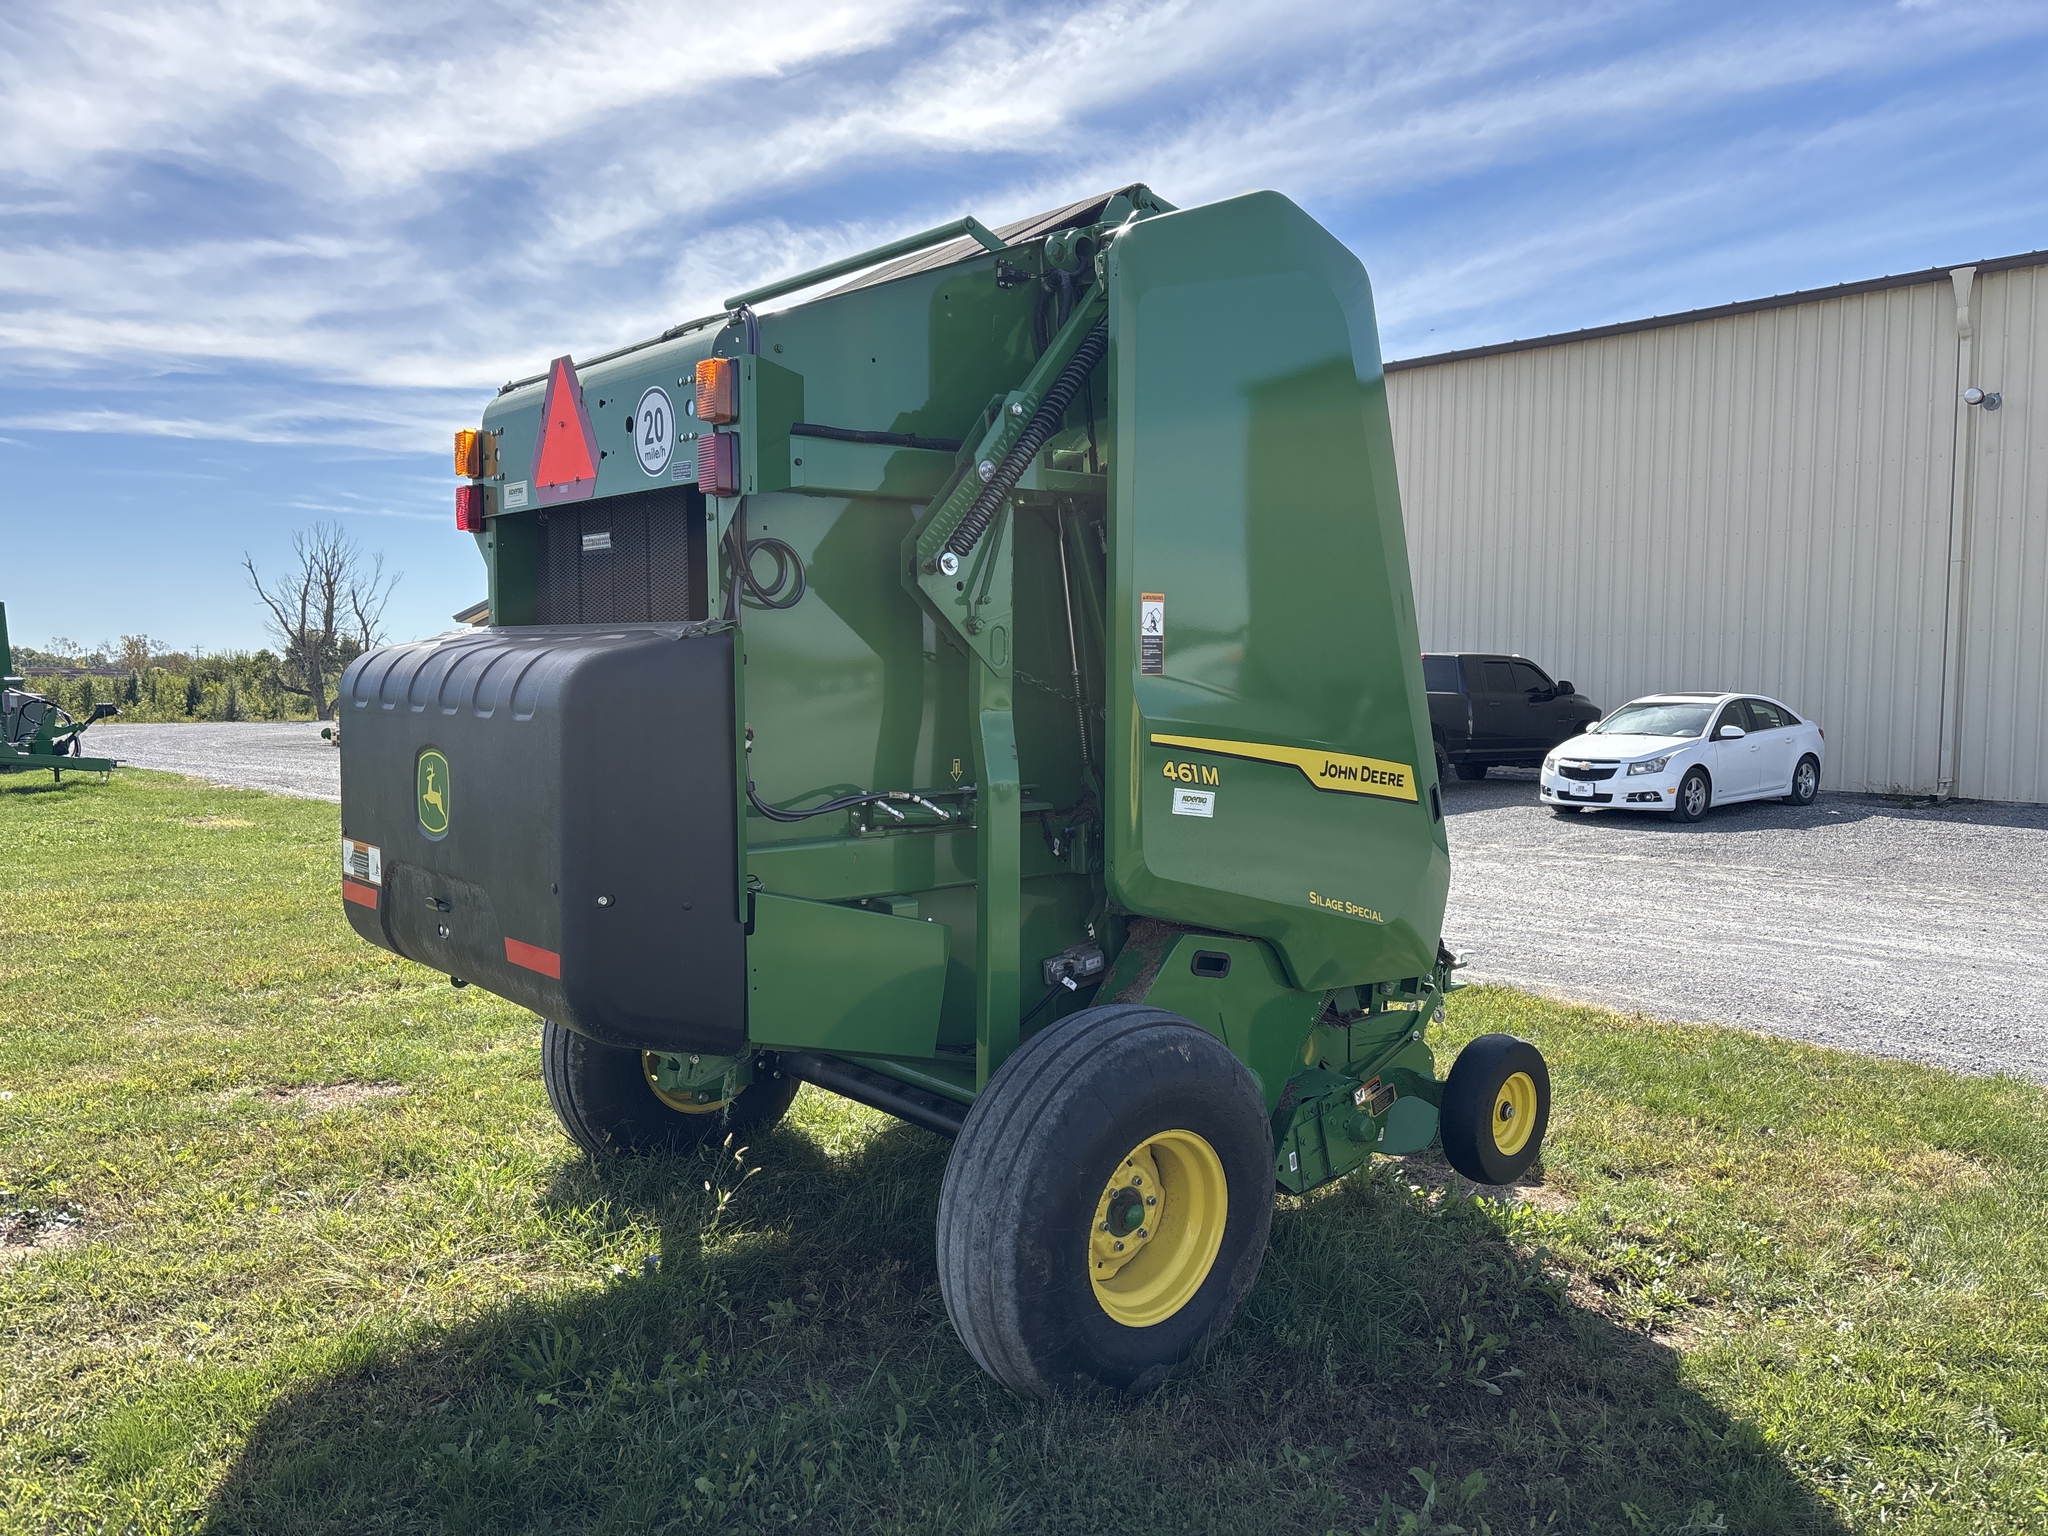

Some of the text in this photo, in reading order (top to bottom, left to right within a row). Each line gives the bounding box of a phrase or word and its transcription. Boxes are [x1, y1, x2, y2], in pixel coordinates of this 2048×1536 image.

[644, 407, 664, 446] 20
[644, 445, 666, 462] mile/h
[1162, 760, 1220, 786] 461M
[1319, 760, 1405, 787] JOHN DEERE
[1309, 891, 1384, 923] SILAGE SPECIAL
